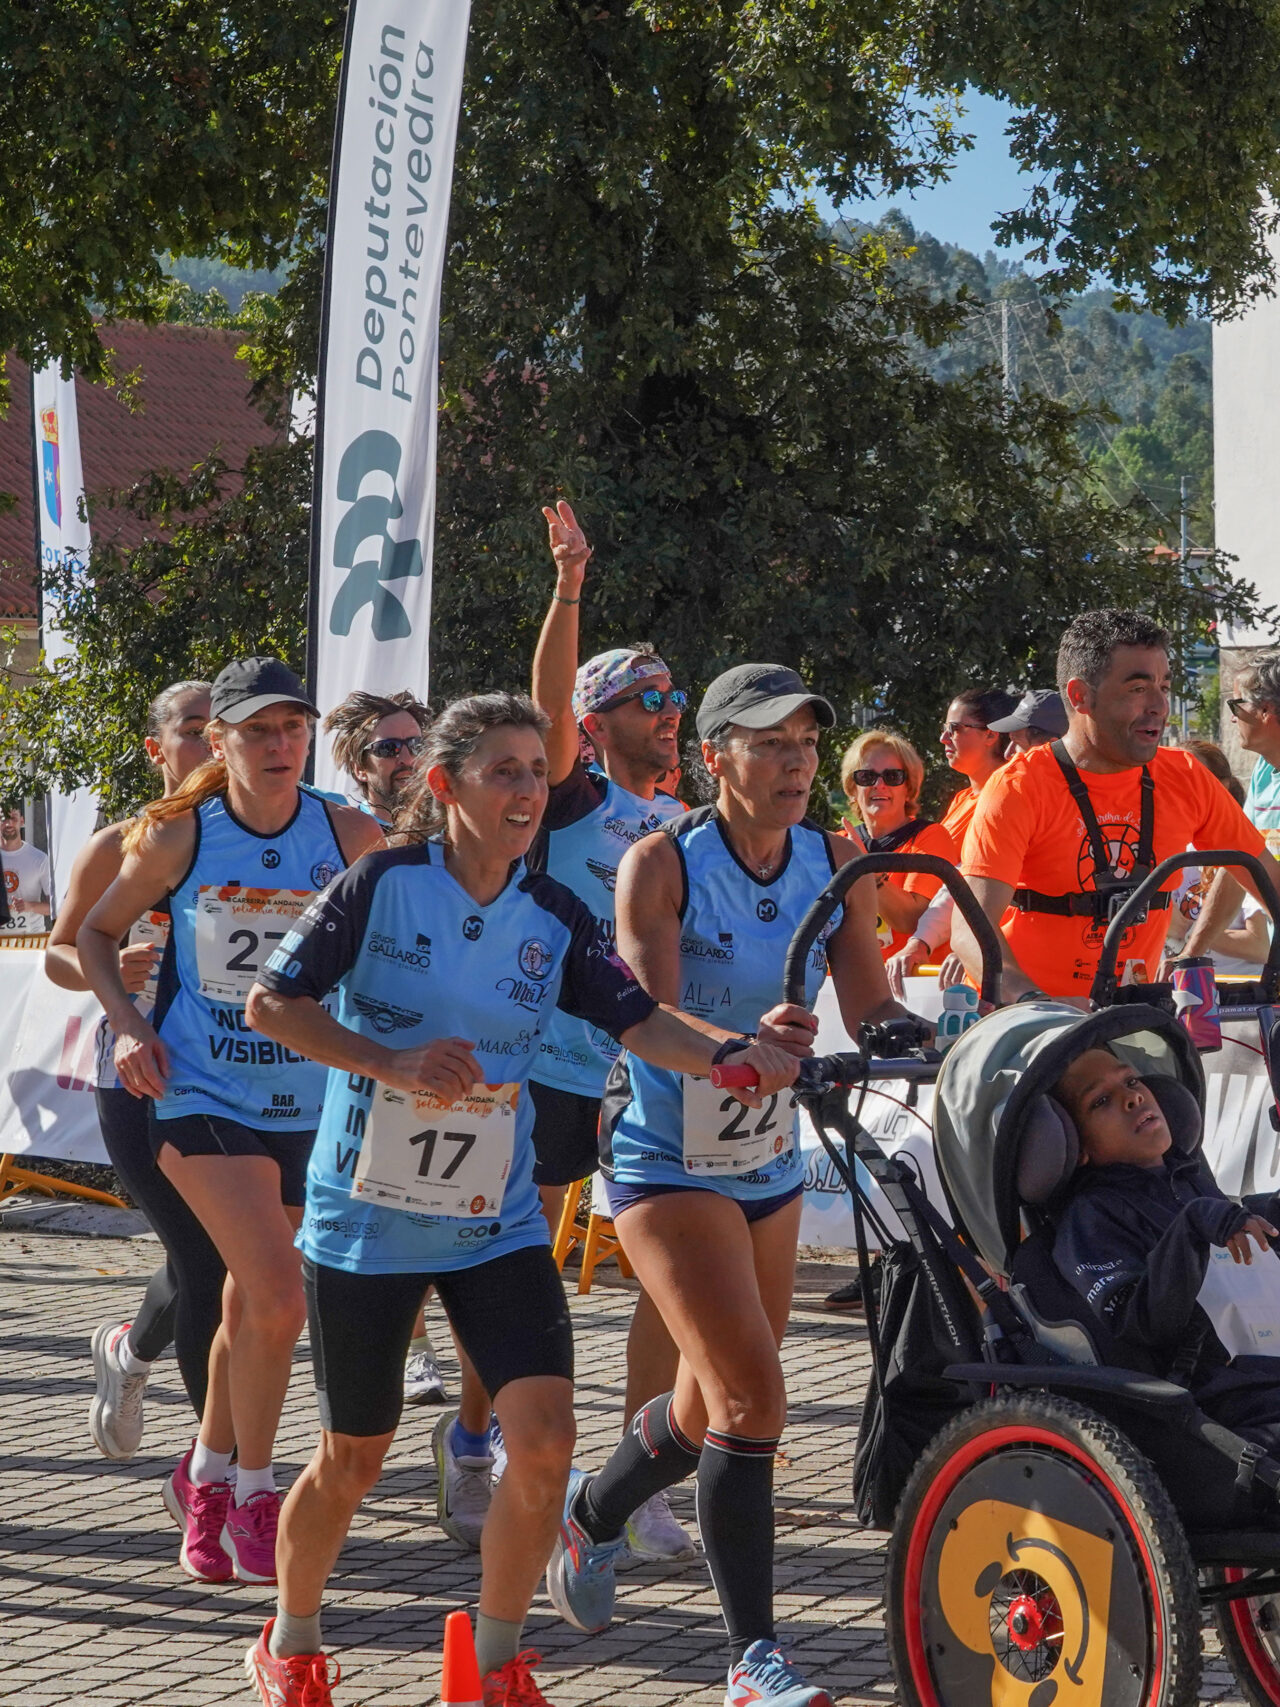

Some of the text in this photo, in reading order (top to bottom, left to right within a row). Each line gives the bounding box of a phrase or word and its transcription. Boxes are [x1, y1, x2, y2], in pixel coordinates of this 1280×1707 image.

[355, 24, 406, 391] Deputación
[391, 40, 435, 403] Pontevedra
[370, 931, 397, 945] Grupo
[680, 942, 734, 961] GALLARDO
[368, 940, 431, 968] GALLARDO
[261, 1107, 301, 1118] PITILLO
[272, 1094, 295, 1107] BAR
[409, 1129, 477, 1180] 17
[922, 1259, 961, 1347] MARATHON
